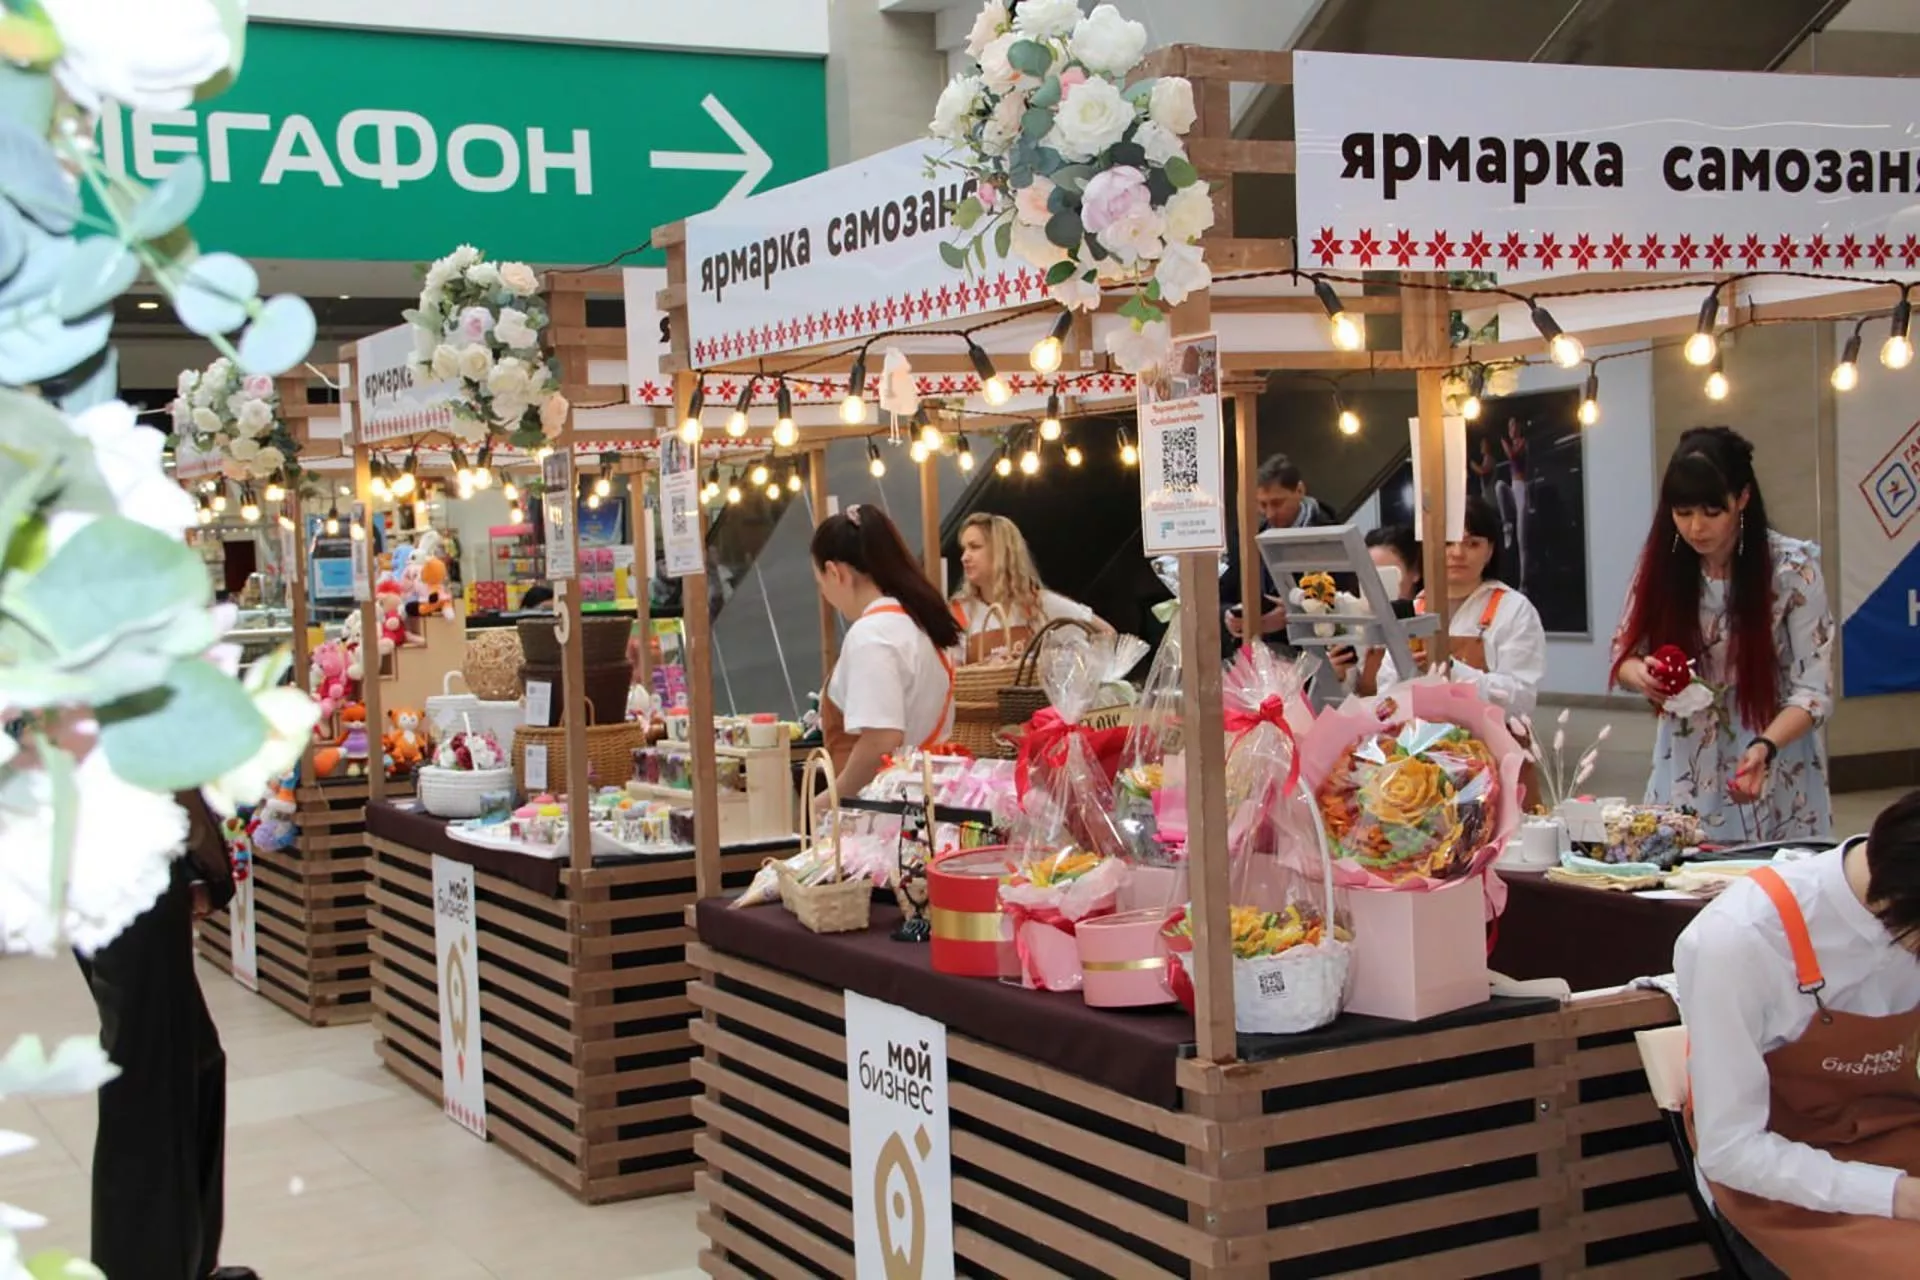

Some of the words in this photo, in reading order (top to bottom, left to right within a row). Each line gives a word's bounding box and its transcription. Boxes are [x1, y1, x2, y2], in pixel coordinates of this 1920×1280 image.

[1340, 132, 1624, 204] ярмарка
[1663, 145, 1920, 194] самозан
[701, 226, 811, 303] ярмарка
[859, 1049, 934, 1115] бизнес
[887, 1039, 932, 1082] мой
